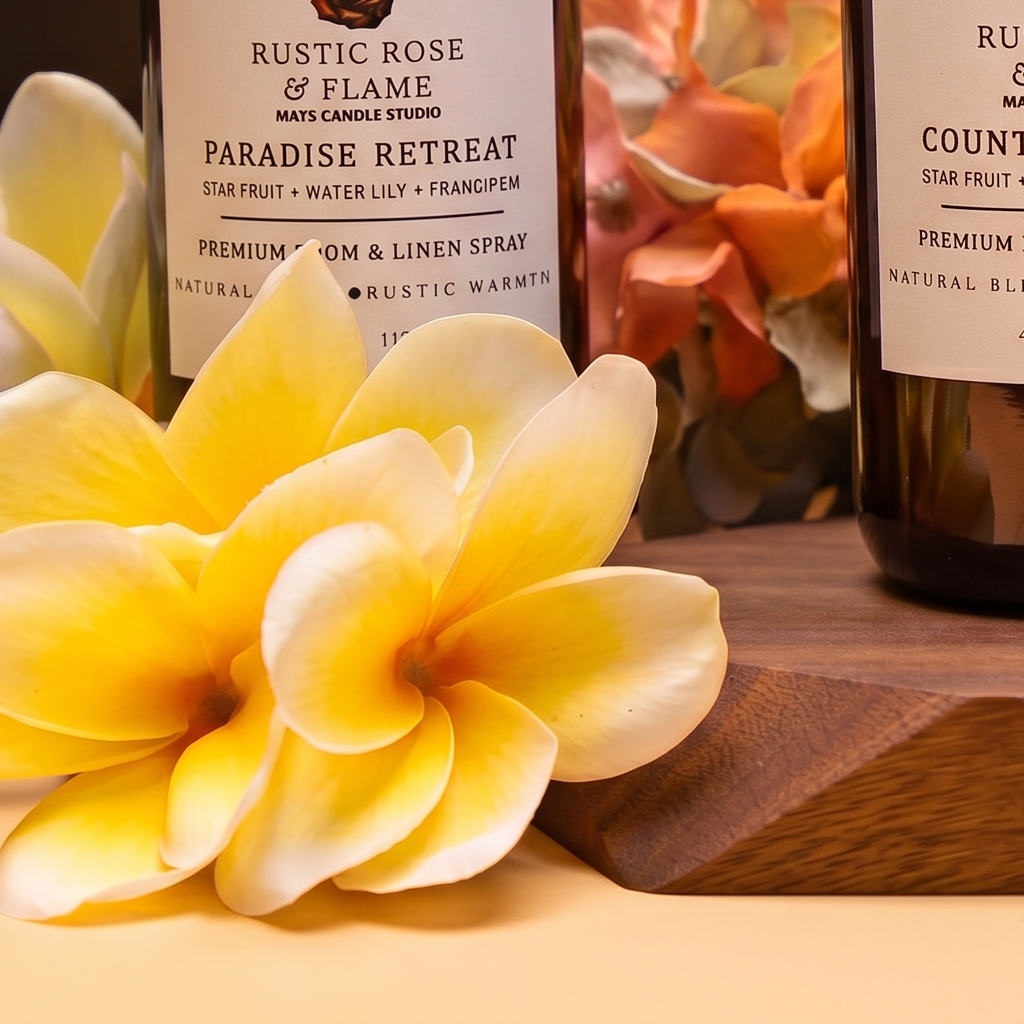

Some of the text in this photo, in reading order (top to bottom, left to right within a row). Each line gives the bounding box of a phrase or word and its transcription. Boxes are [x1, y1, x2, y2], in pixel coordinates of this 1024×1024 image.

[251, 38, 464, 66] RUSTIC ROSE
[283, 75, 432, 101] & FLAME
[275, 105, 442, 123] MAYS CANDLE STUDIO
[204, 134, 517, 168] PARADISE RETREAT
[202, 180, 236, 198] STAR
[240, 182, 285, 200] FRUIT
[290, 187, 300, 198] +
[305, 184, 366, 201] WATER
[371, 182, 407, 200] LILY
[413, 184, 424, 196] +
[921, 168, 959, 187] STAR
[964, 171, 1012, 189] FRUIT
[198, 232, 528, 262] PREMIUM OM & LINEN SPRAY
[918, 228, 1013, 252] PREMIUM
[175, 277, 253, 299] NATURAL
[366, 281, 456, 300] RUSTIC
[888, 267, 976, 291] NATURAL
